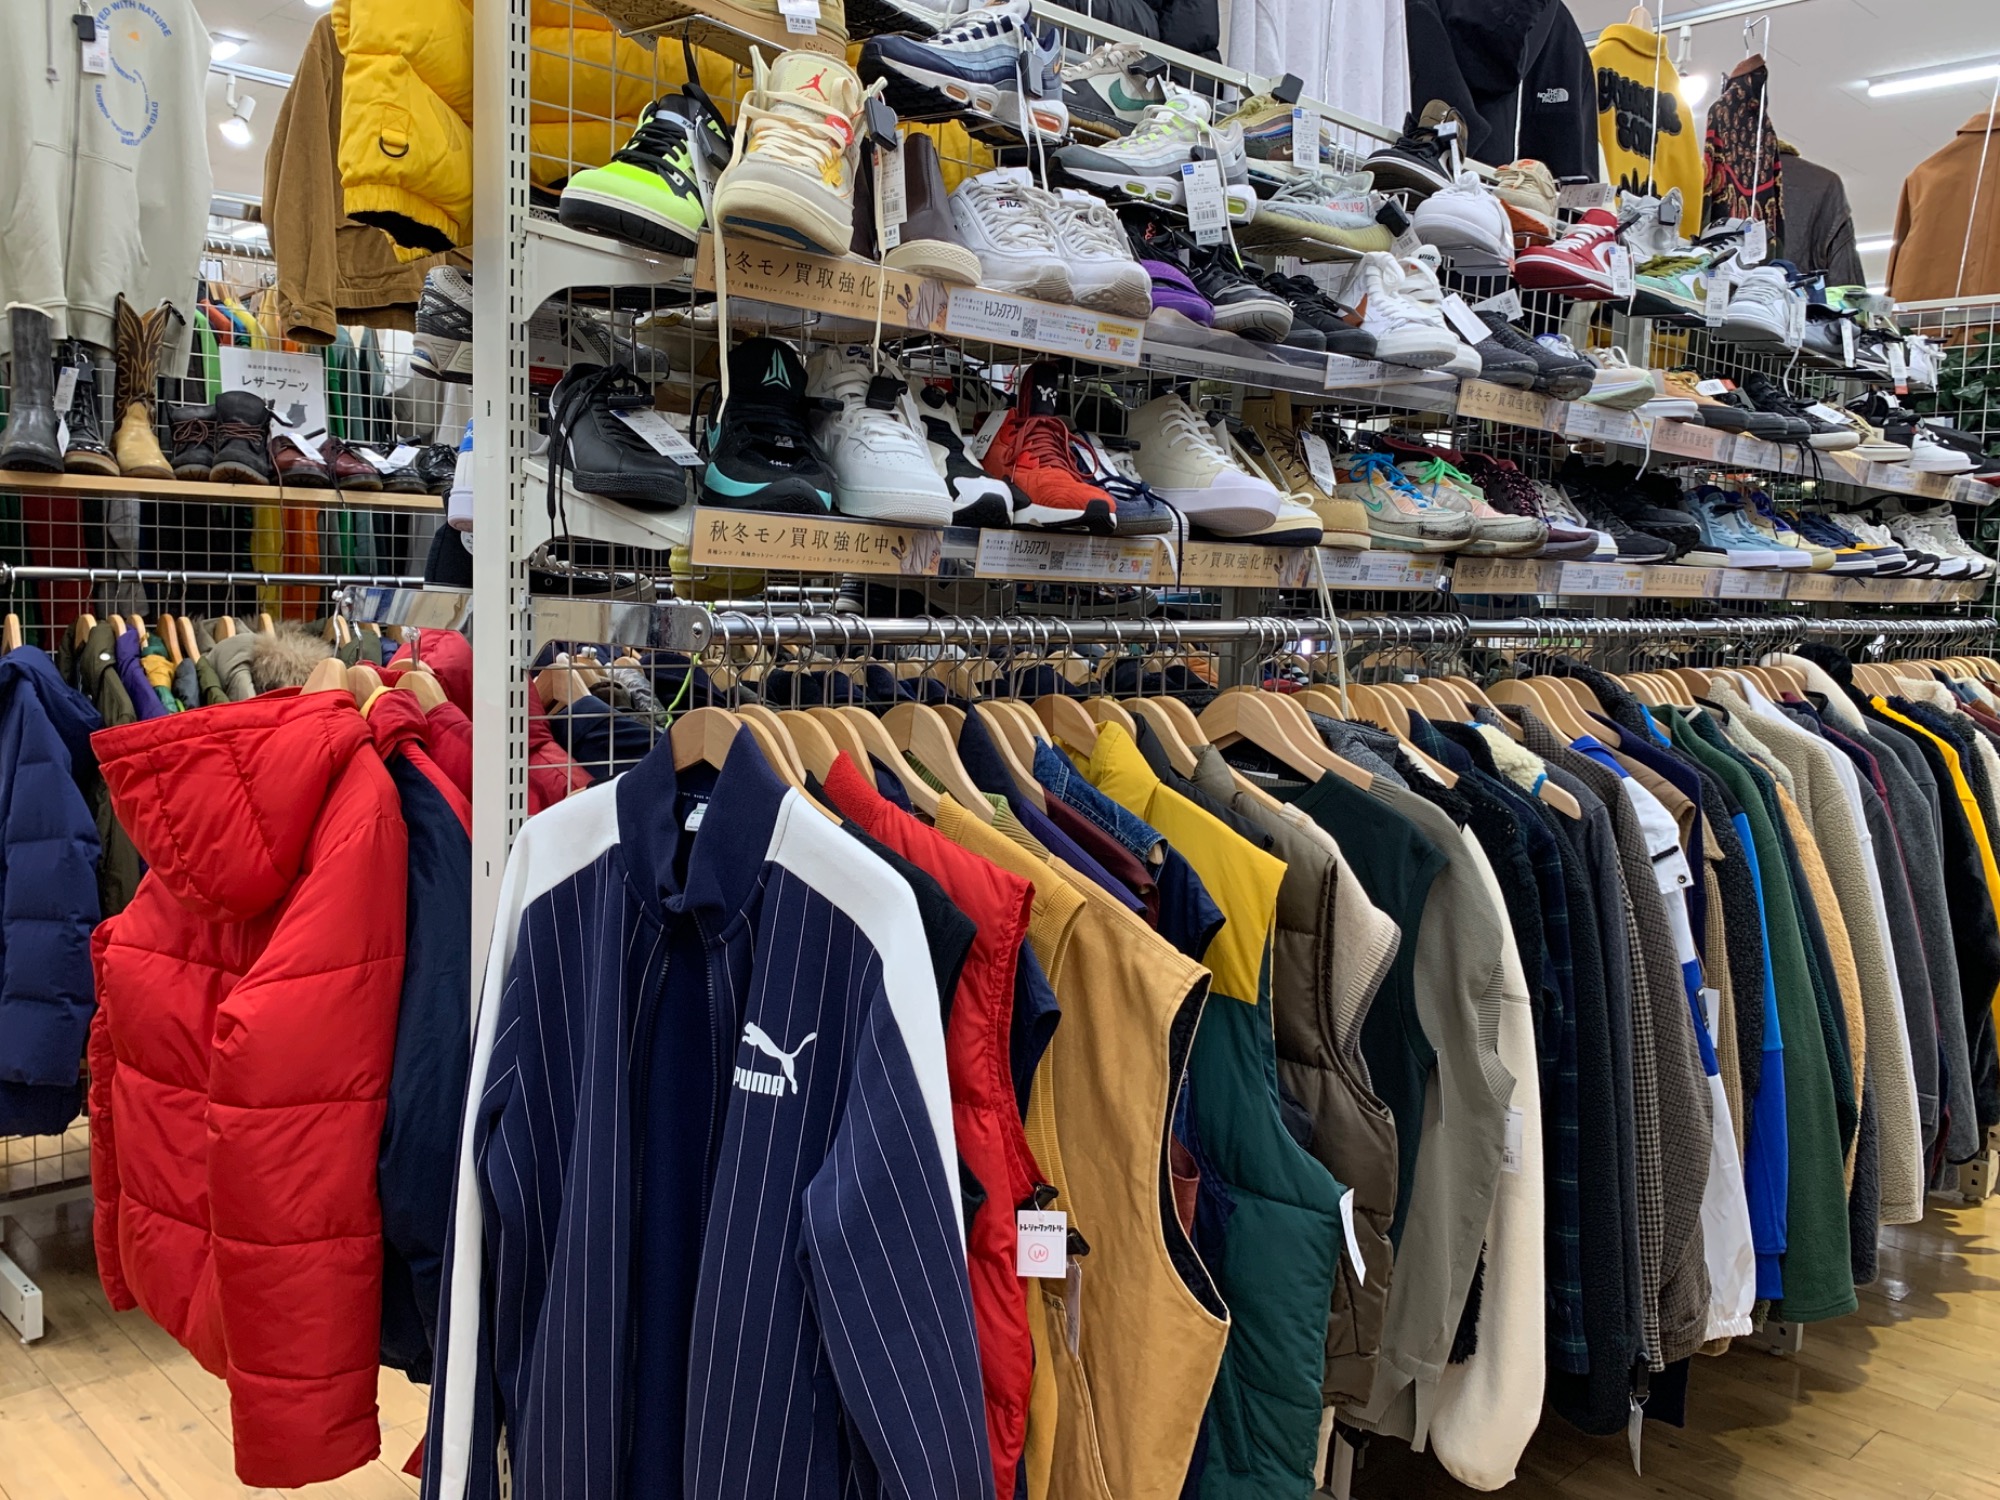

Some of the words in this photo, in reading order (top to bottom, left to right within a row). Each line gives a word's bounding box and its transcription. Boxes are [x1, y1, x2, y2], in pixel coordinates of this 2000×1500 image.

[110, 0, 137, 11] WITH
[138, 2, 172, 38] NATURE
[998, 200, 1022, 208] FILA
[241, 375, 309, 392] レザーブーツ
[710, 520, 889, 554] 秋冬モノ買取強化中
[733, 1065, 785, 1097] PUMA
[1019, 1223, 1064, 1233] トレジャーファクトリー
